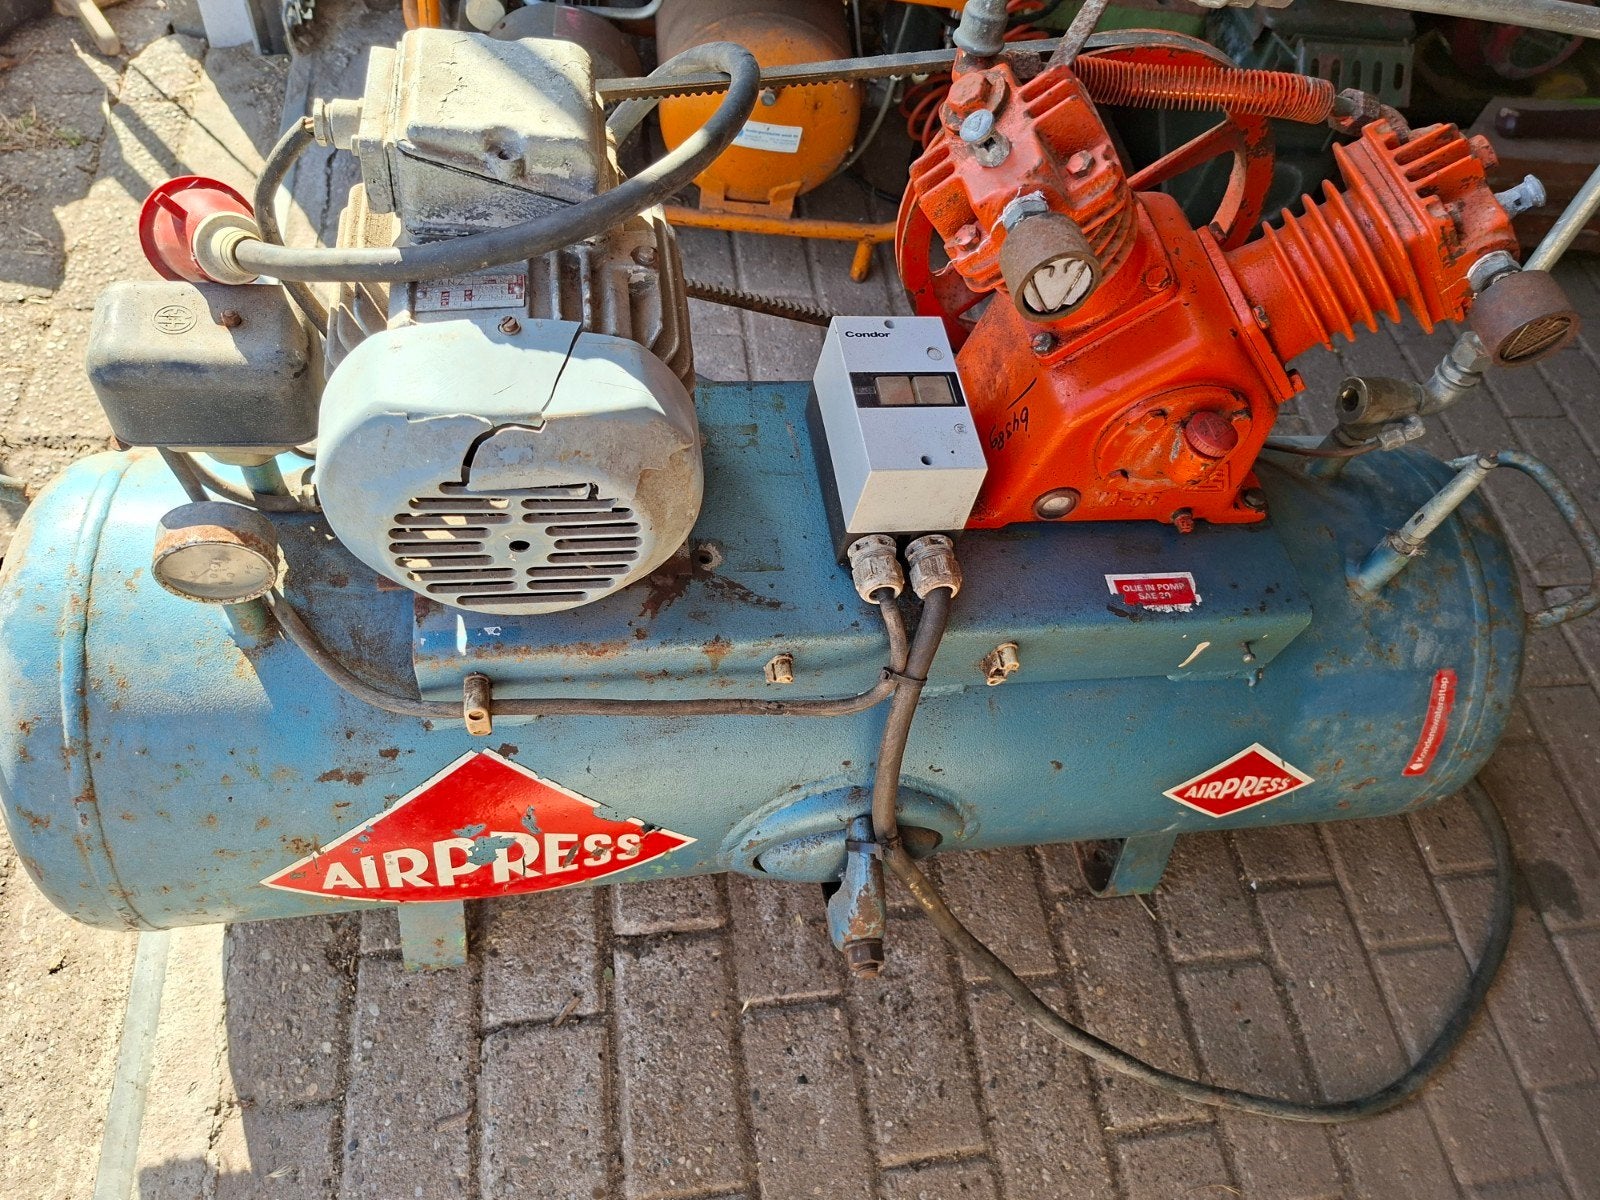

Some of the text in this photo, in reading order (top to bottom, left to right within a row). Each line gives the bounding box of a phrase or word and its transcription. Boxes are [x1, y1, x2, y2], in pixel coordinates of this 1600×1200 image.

[1122, 584, 1144, 592] OLIE
[1157, 583, 1184, 591] POMP
[1138, 592, 1158, 600] SAE
[1184, 775, 1290, 799] AIRPRESS
[322, 831, 643, 889] AIRPRESS
